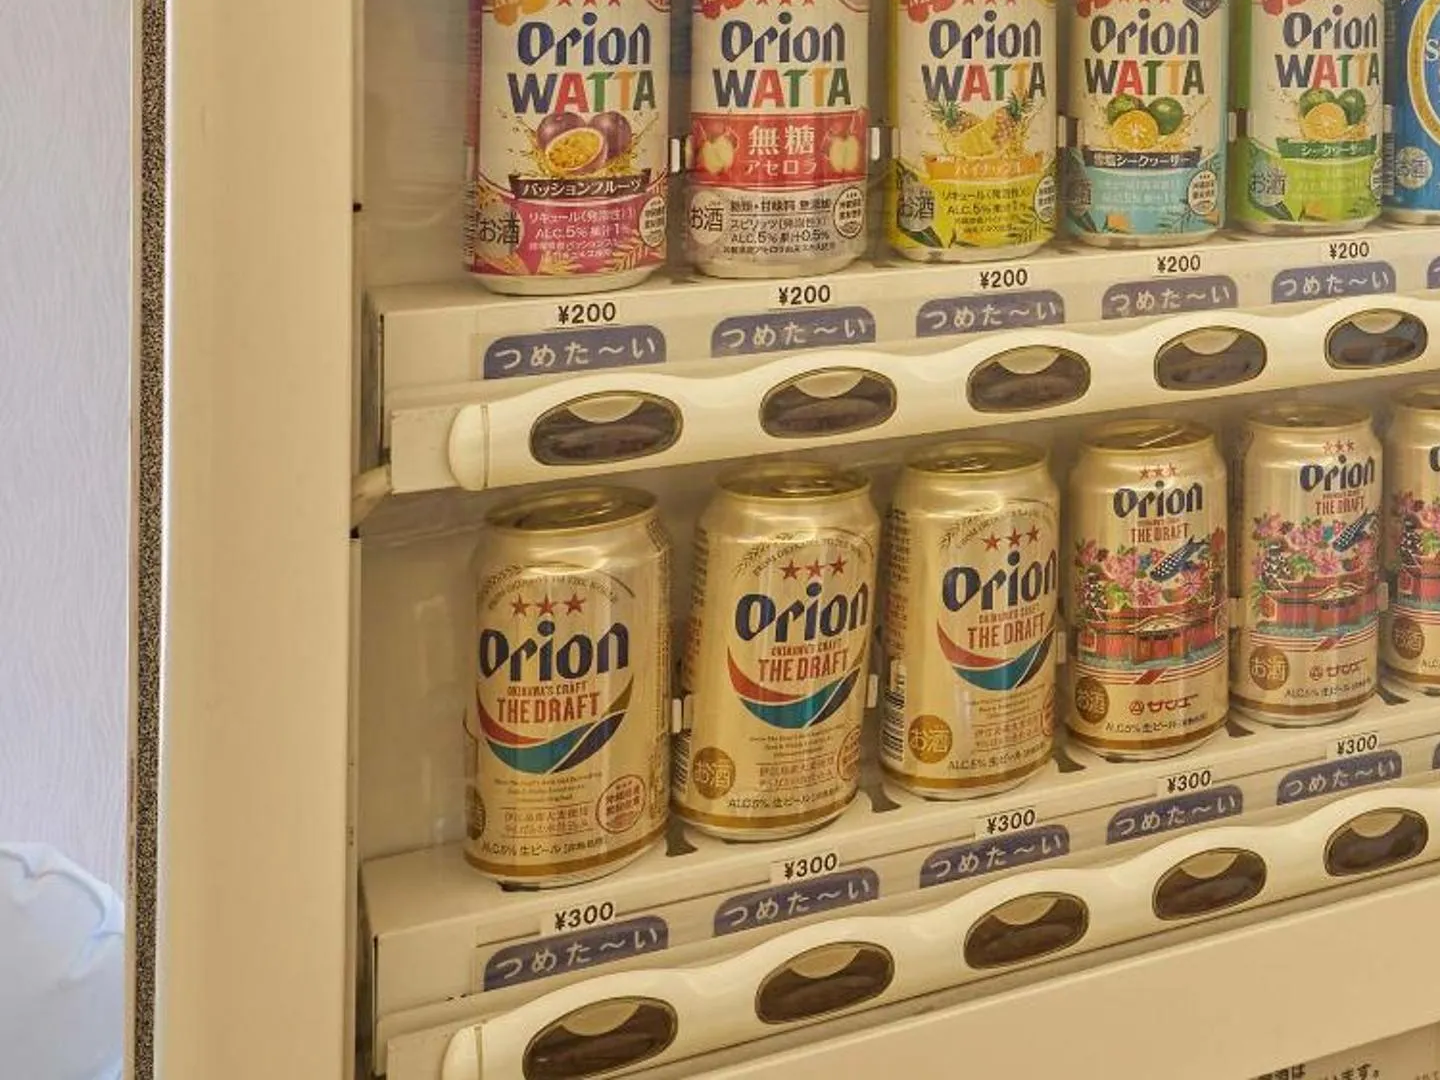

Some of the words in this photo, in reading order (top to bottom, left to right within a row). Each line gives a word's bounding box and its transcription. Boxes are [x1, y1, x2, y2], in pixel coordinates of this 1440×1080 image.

[517, 12, 651, 66] Orion
[721, 12, 845, 66] Orion
[928, 10, 1041, 60] Orion
[1090, 8, 1199, 55] Orion
[1283, 5, 1378, 50] Orion
[920, 63, 1046, 103] WATTA
[1084, 59, 1205, 97] WATTA
[1275, 54, 1380, 90] WATTA
[507, 70, 657, 113] WATTA
[712, 69, 852, 108] WATTA
[748, 125, 816, 156] 無糖
[744, 159, 818, 176] アセロラ
[522, 180, 642, 197] パッションフルーツ
[479, 218, 520, 245] お酒
[690, 206, 724, 232] お酒
[1155, 253, 1202, 273] ¥200
[1328, 241, 1371, 260] ¥200
[978, 268, 1029, 289] ¥200
[777, 283, 832, 306] ¥200
[557, 301, 617, 325] ¥200
[1299, 454, 1375, 492] Orion
[1112, 480, 1204, 519] Orion
[1315, 499, 1335, 516] THE
[1336, 495, 1365, 514] DRAFT
[1130, 526, 1153, 543] THE
[1153, 522, 1189, 541] DRAFT
[941, 549, 1058, 612] Orion
[734, 581, 869, 643] Orion
[967, 625, 1000, 649] THE
[1003, 612, 1046, 647] DRAFT
[479, 620, 630, 682] Orion
[758, 658, 793, 683] THE
[794, 650, 849, 680] DRAFT
[1252, 655, 1288, 682] お酒
[497, 699, 531, 724] THE
[533, 691, 600, 723] DRAFT
[908, 726, 950, 753] お酒
[1335, 733, 1379, 756] ¥300
[1166, 770, 1213, 794] ¥300
[985, 809, 1037, 835] ¥300
[783, 852, 838, 881] ¥300
[554, 900, 616, 931] ¥300
